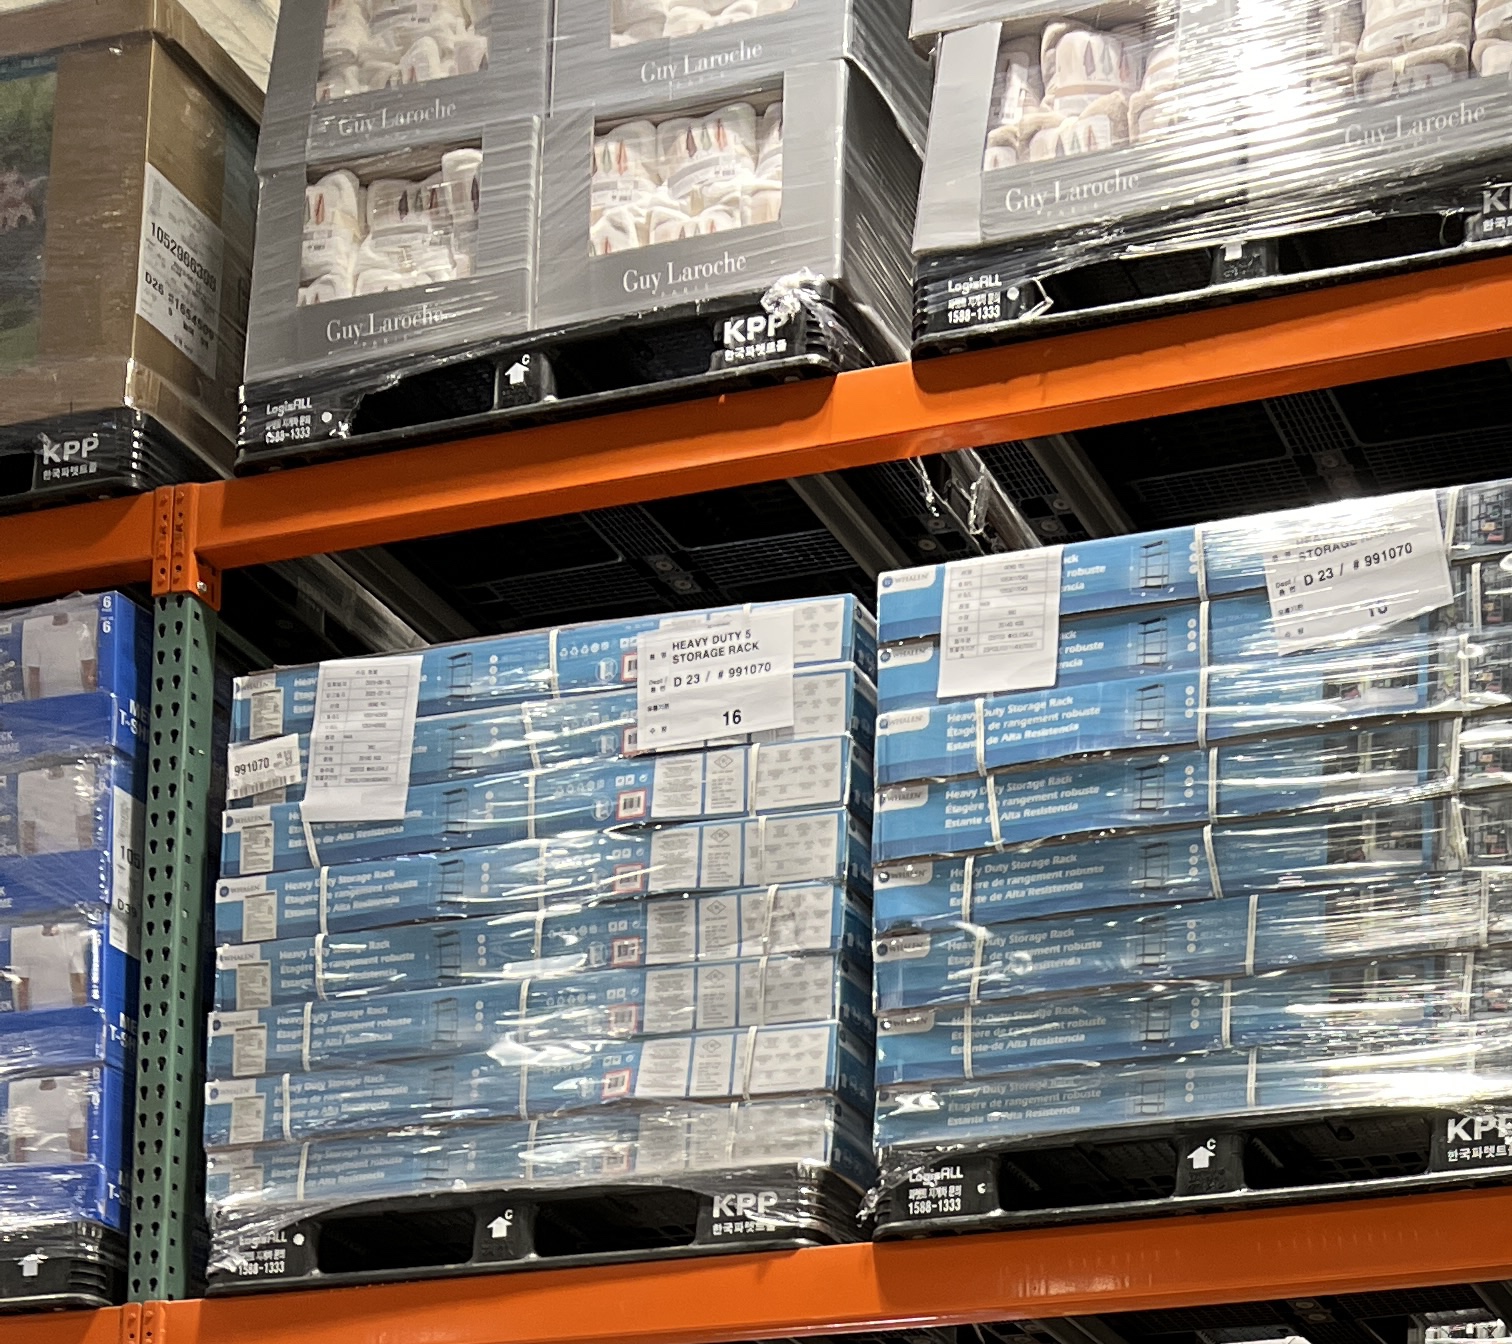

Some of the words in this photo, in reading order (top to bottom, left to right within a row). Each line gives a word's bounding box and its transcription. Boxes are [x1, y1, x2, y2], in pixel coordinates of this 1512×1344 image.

[641, 61, 676, 84] Guy
[684, 41, 762, 74] Laroche
[1005, 187, 1046, 213] Guy
[1055, 171, 1139, 203] Laroche
[623, 269, 660, 292] Guy
[667, 252, 746, 283] Laroche
[948, 305, 1000, 324] 1588-1333
[327, 319, 362, 342] Guy
[724, 314, 787, 345] KPP
[42, 438, 98, 465] KPP
[1319, 568, 1333, 581] 23
[1365, 542, 1412, 567] 991070
[672, 638, 708, 650] HEAVY
[712, 632, 741, 644] DUTY
[746, 629, 751, 639] 5
[672, 647, 725, 664] STORAGE
[729, 642, 759, 655] RACK
[674, 677, 681, 687] D
[687, 674, 700, 685] 23
[729, 662, 771, 677] 991070
[723, 709, 741, 726] 16
[234, 757, 269, 776] 991070
[712, 1191, 777, 1217] KPP
[908, 1197, 961, 1216] 1588-1333
